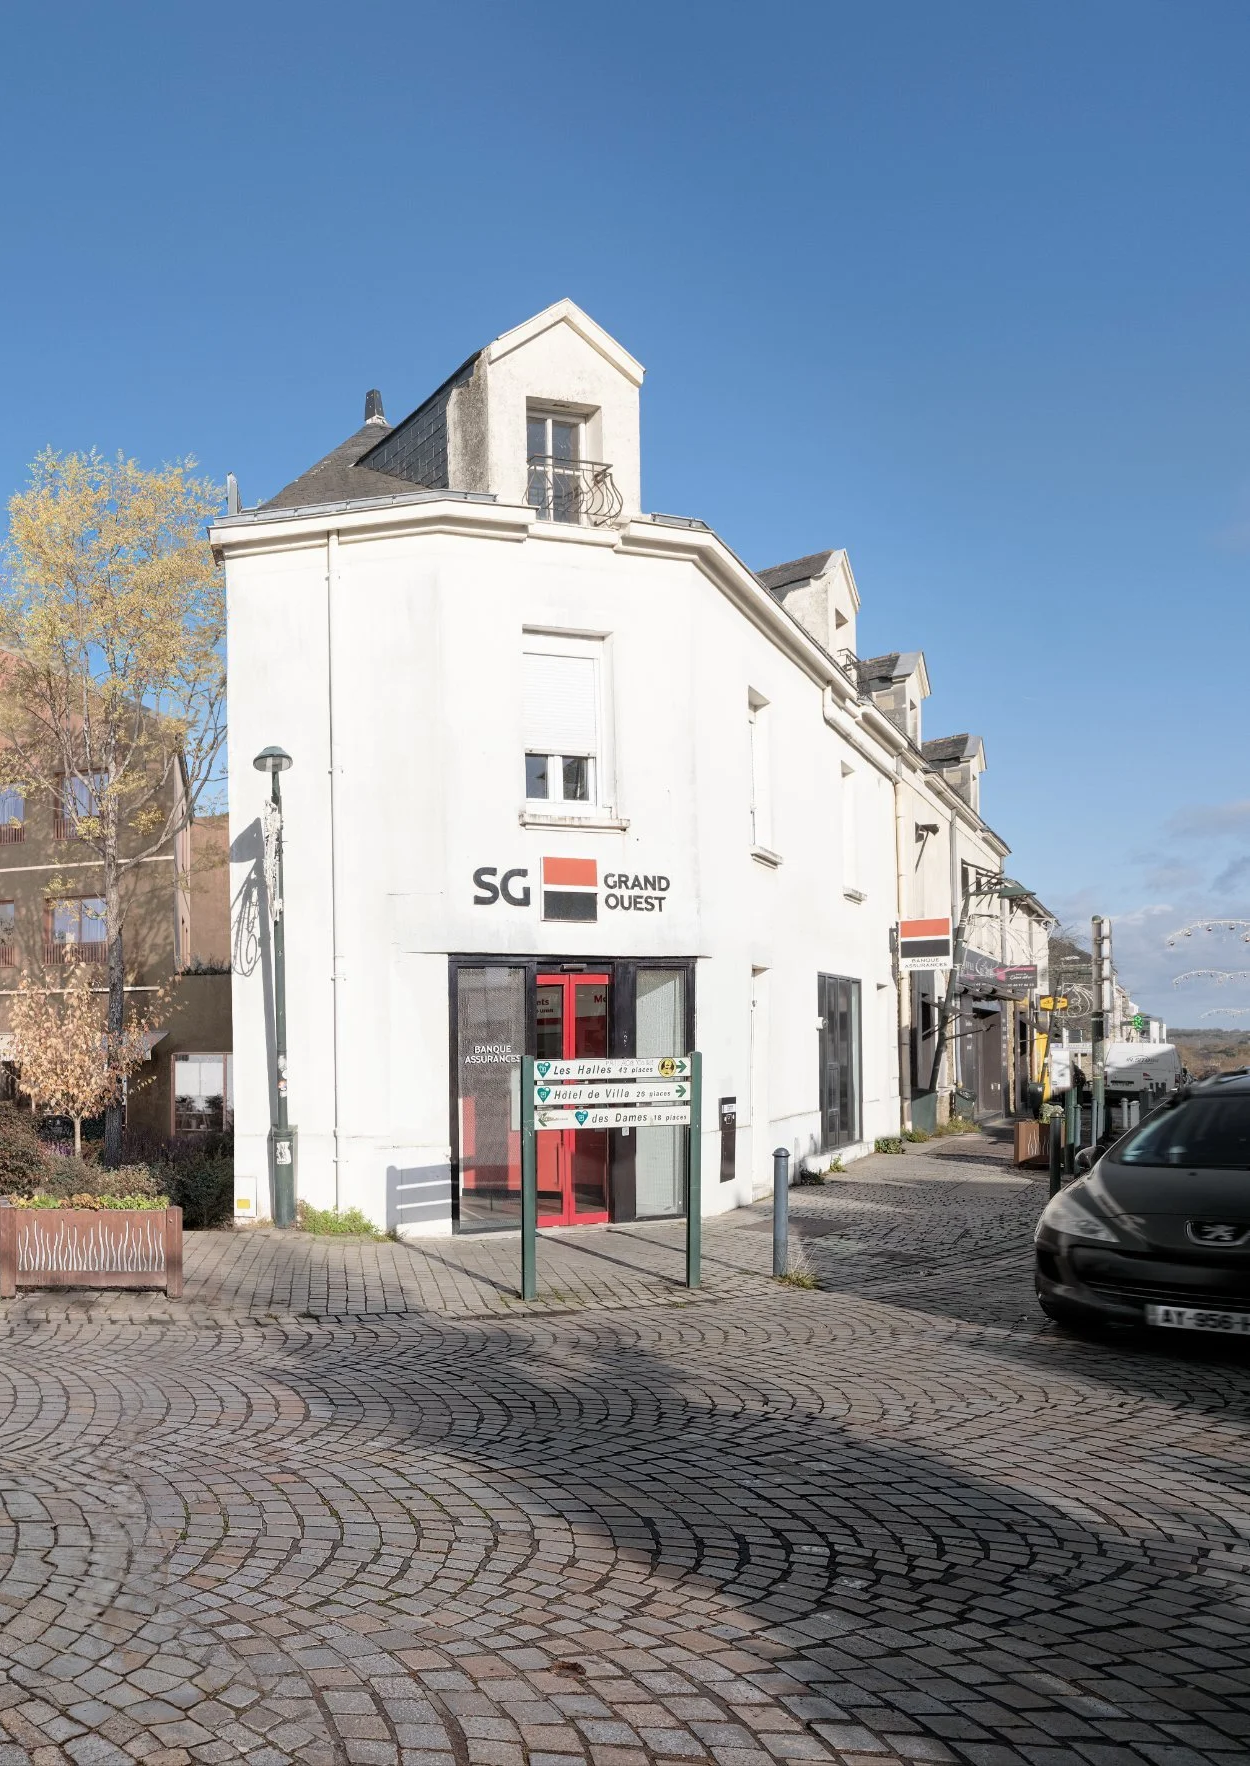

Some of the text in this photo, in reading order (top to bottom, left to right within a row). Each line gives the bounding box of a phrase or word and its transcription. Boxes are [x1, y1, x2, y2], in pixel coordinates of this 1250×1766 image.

[472, 866, 531, 907] SG
[603, 872, 671, 892] GRAND
[604, 893, 667, 912] OUEST
[474, 1045, 512, 1054] BANQUE
[464, 1054, 521, 1064] ASSURANCES
[553, 1065, 571, 1075] Les
[577, 1063, 612, 1075] Halles
[631, 1066, 654, 1074] places
[587, 1089, 600, 1099] de
[605, 1088, 630, 1098] Ville
[649, 1090, 671, 1098] places
[592, 1113, 609, 1123] des
[615, 1112, 648, 1123] Dames
[665, 1113, 687, 1121] places
